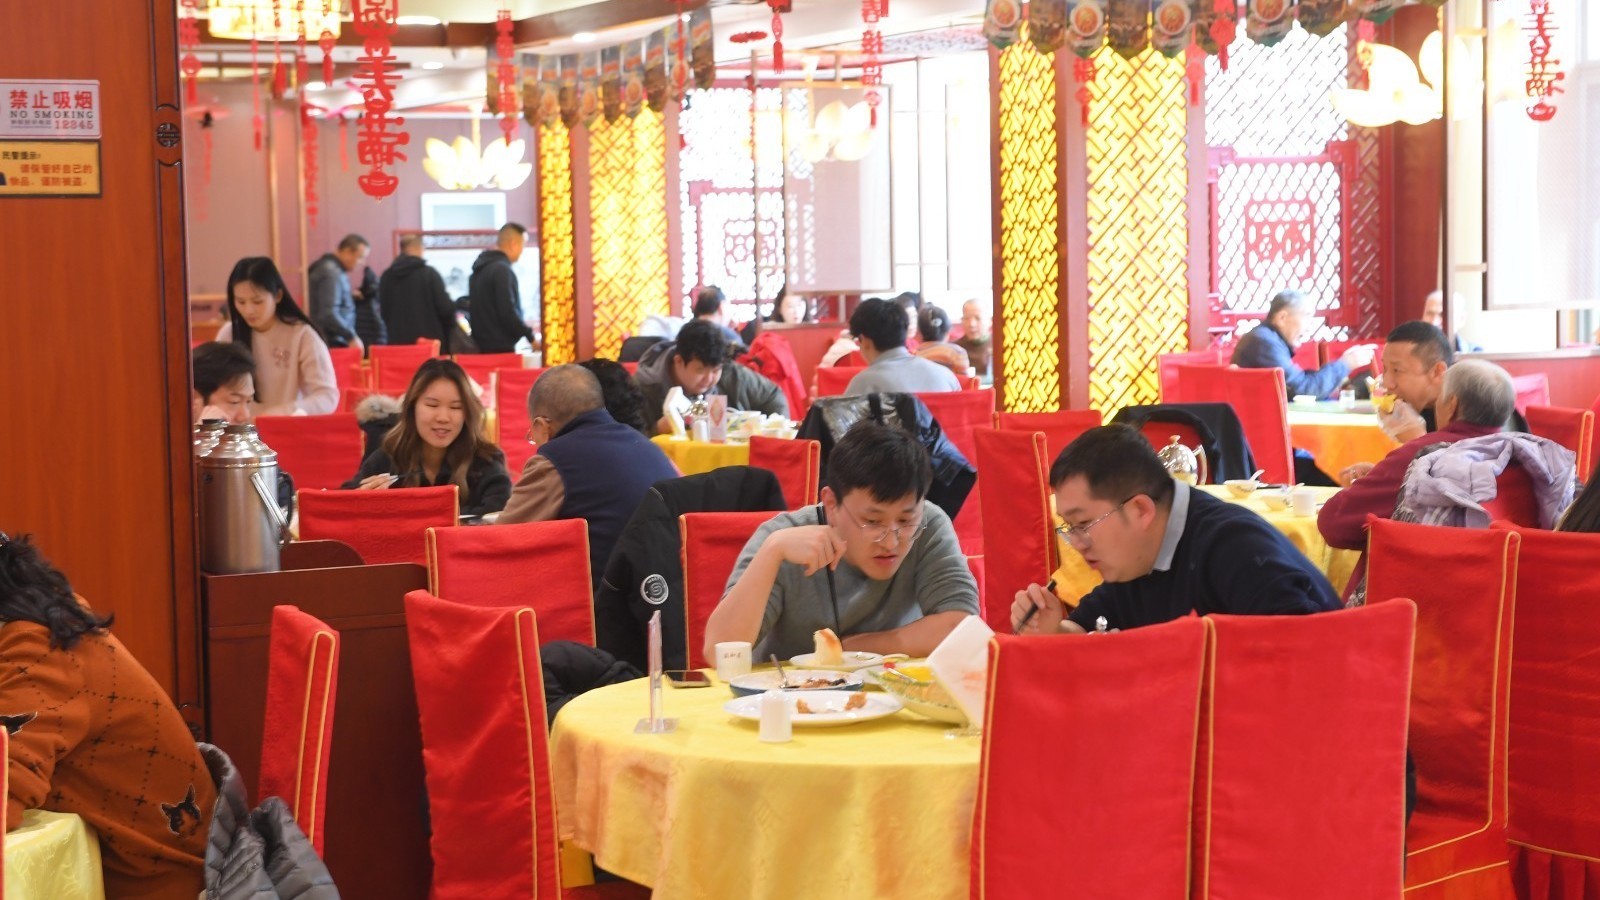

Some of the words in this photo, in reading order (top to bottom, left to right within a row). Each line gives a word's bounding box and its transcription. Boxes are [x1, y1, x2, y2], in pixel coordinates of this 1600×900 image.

[10, 90, 93, 109] 禁止吸烟
[10, 111, 28, 119] NO
[34, 111, 94, 119] SMOKING
[55, 121, 94, 130] 12345
[20, 164, 93, 174] 请保管好自己的
